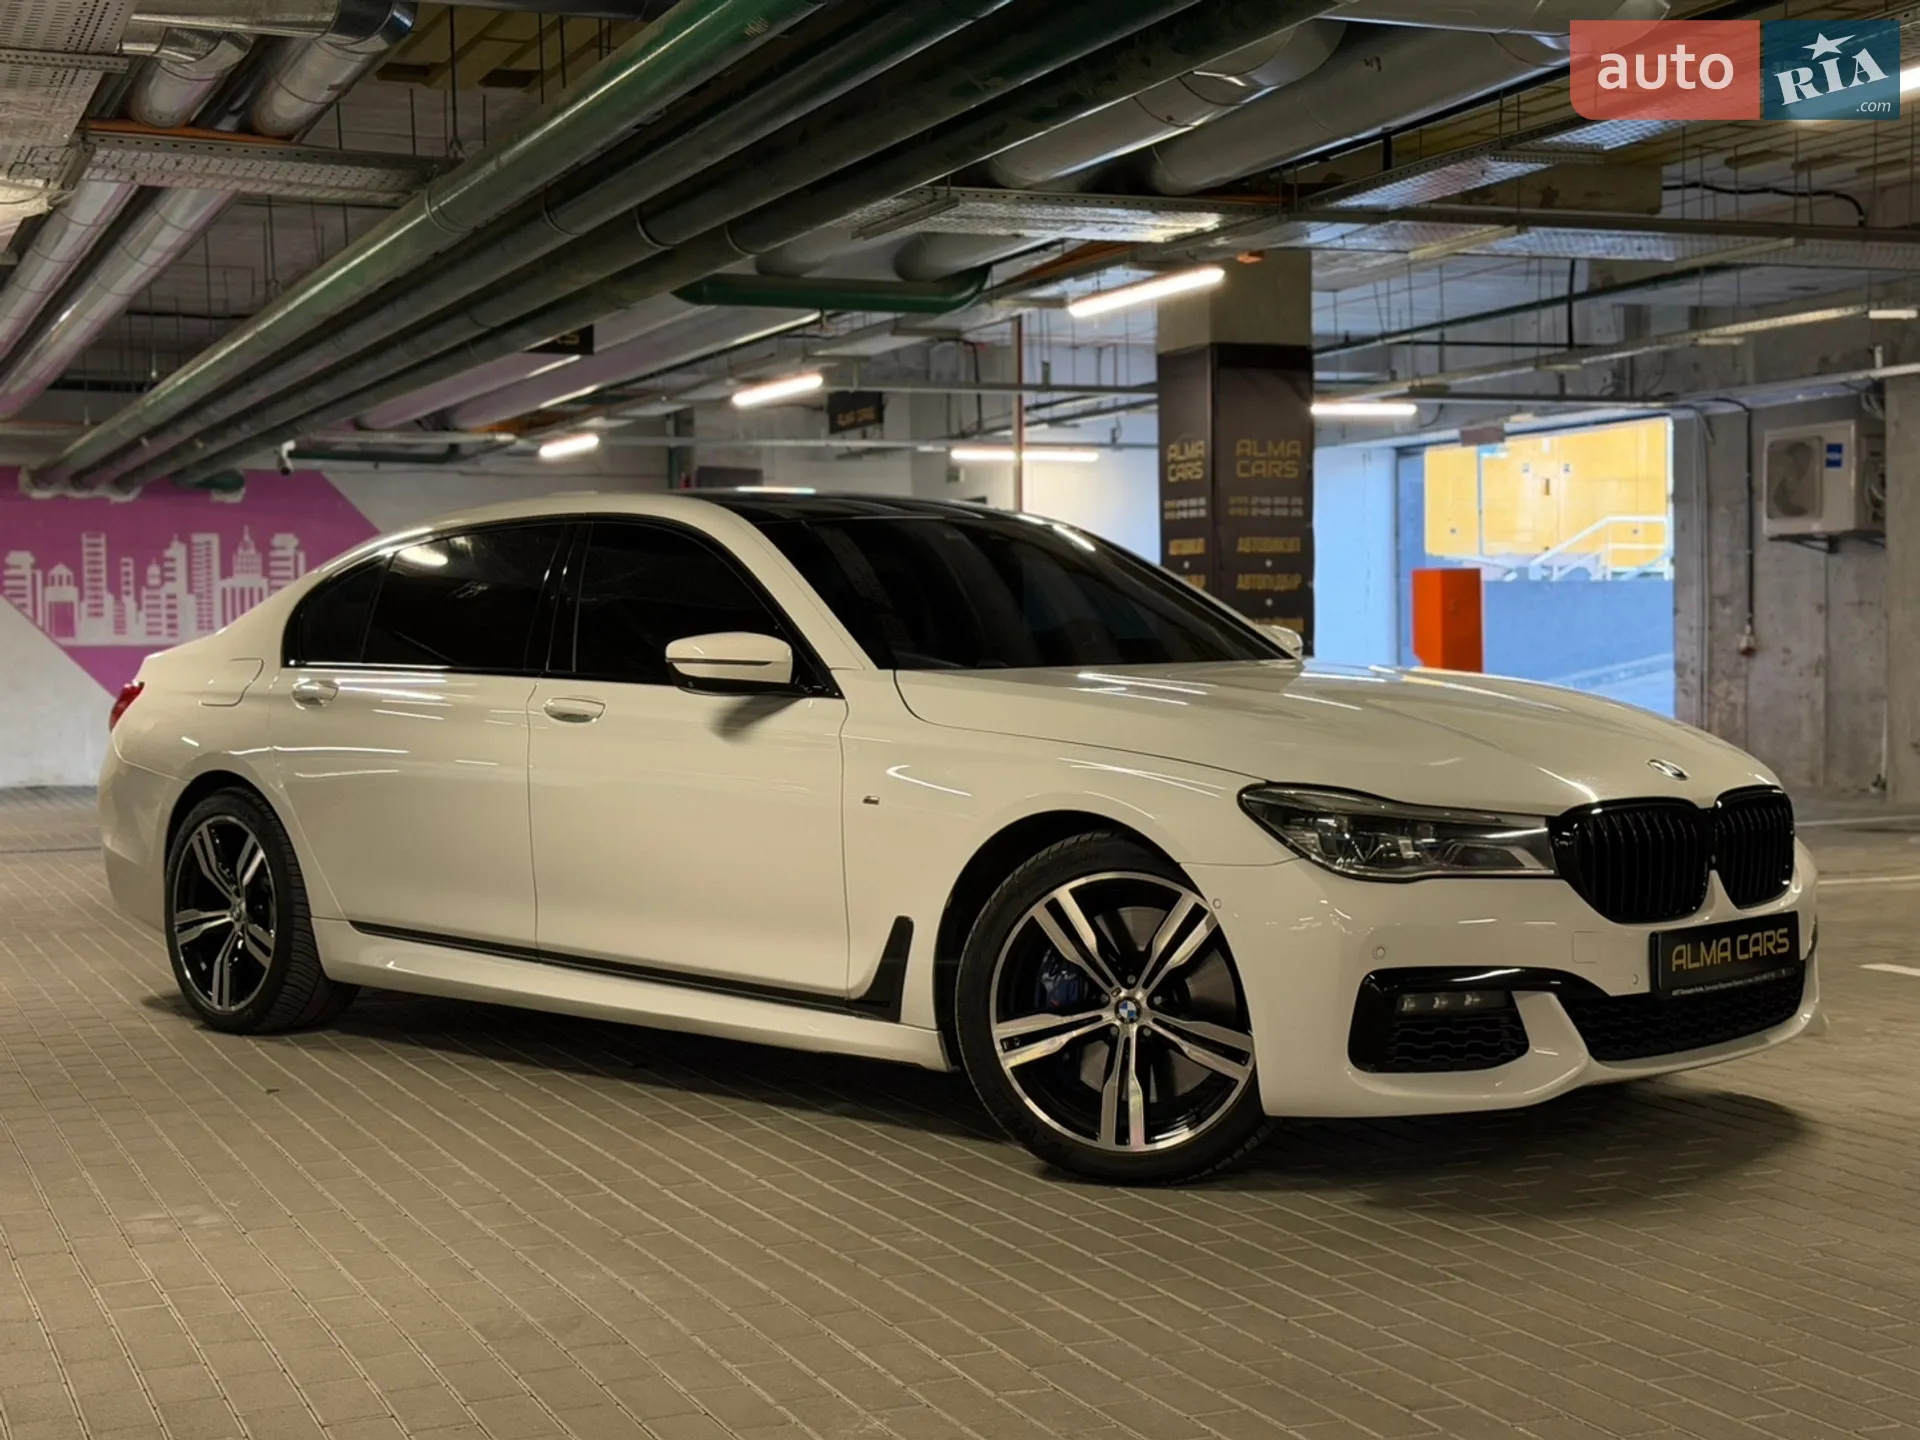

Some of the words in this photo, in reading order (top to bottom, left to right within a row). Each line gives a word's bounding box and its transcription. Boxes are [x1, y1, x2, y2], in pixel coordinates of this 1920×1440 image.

[1167, 440, 1205, 462] ALMA
[1236, 440, 1301, 458] ALMA
[1168, 461, 1204, 482] CARS
[1236, 460, 1299, 478] CARS
[1671, 937, 1732, 972] ALMA
[1736, 928, 1790, 960] CARS
